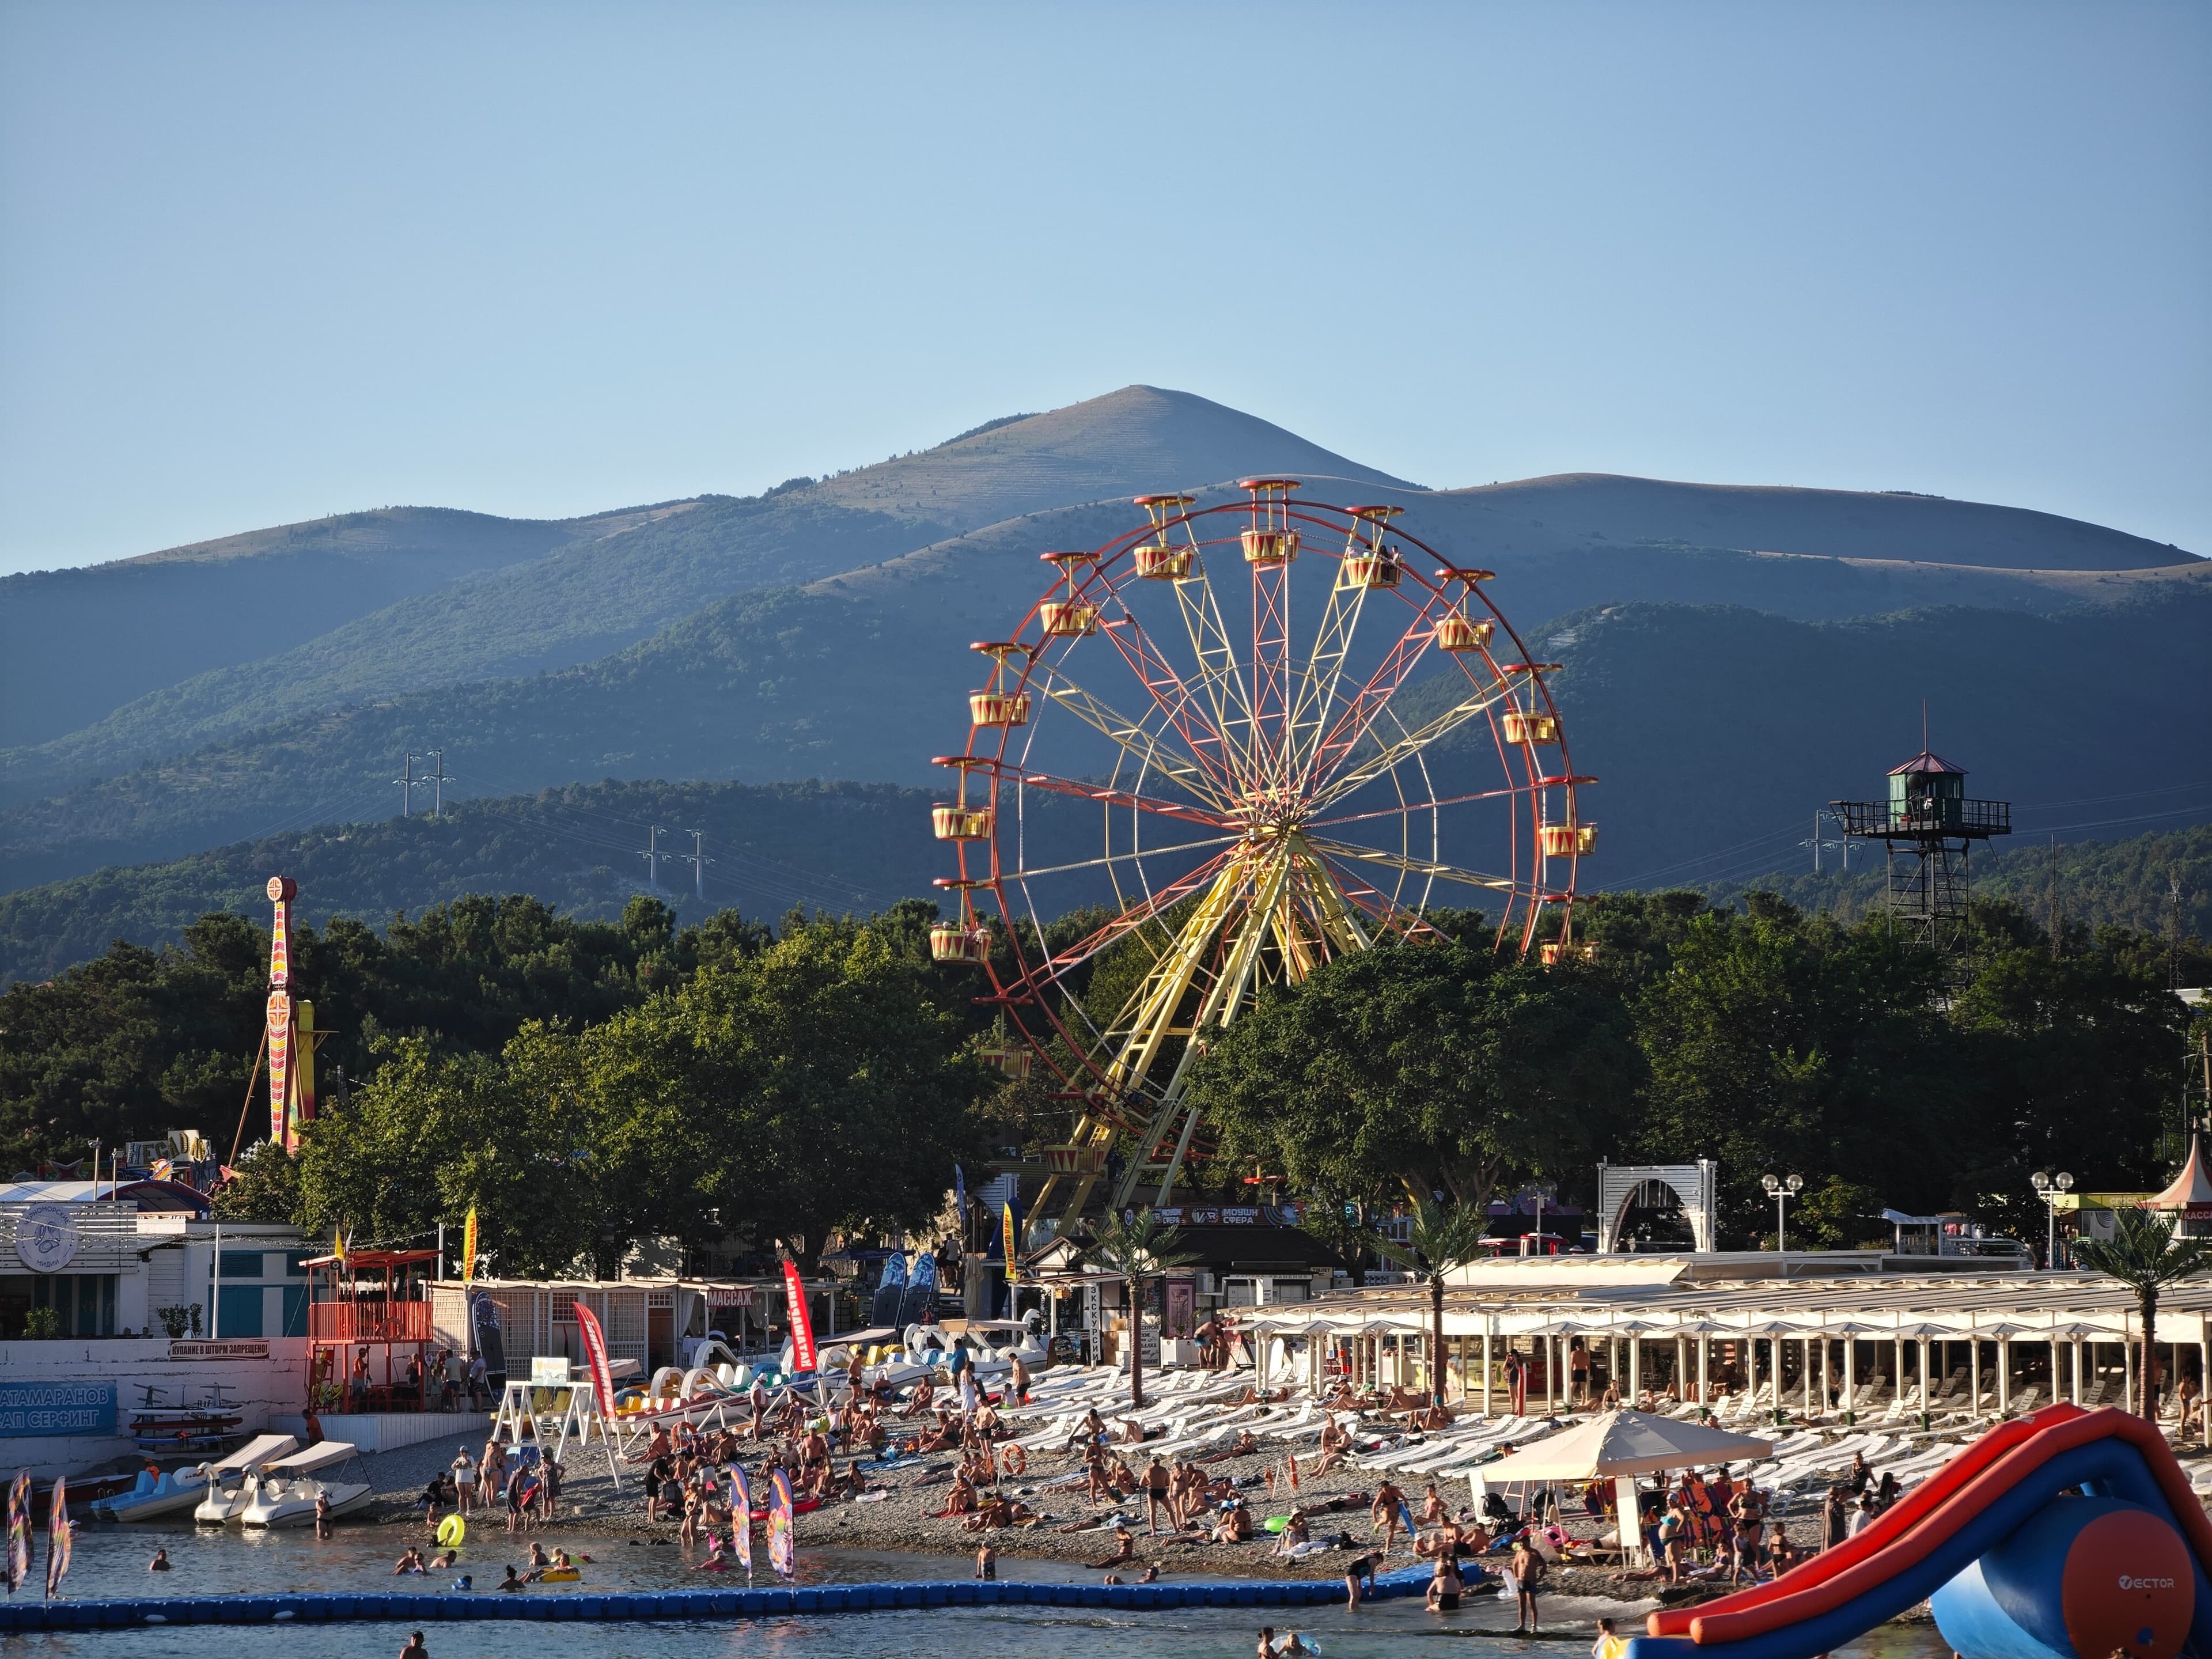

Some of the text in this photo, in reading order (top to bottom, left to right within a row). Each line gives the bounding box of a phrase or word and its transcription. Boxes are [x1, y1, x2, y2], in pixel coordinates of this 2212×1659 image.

[24, 1206, 69, 1225] ЧЕРНОМОРСКИЕ
[465, 1218, 476, 1277] КАТАМАРАНЫ
[36, 1259, 60, 1267] МИДИИ
[708, 1290, 752, 1306] МАССАЖ
[173, 1344, 267, 1355] КУПАНИЕ В ШТОРМ ЗАПРЕЩЕНО!
[0, 1388, 108, 1406] АТАМАРАНОВ
[0, 1410, 99, 1428] АП СЕРФИНГ
